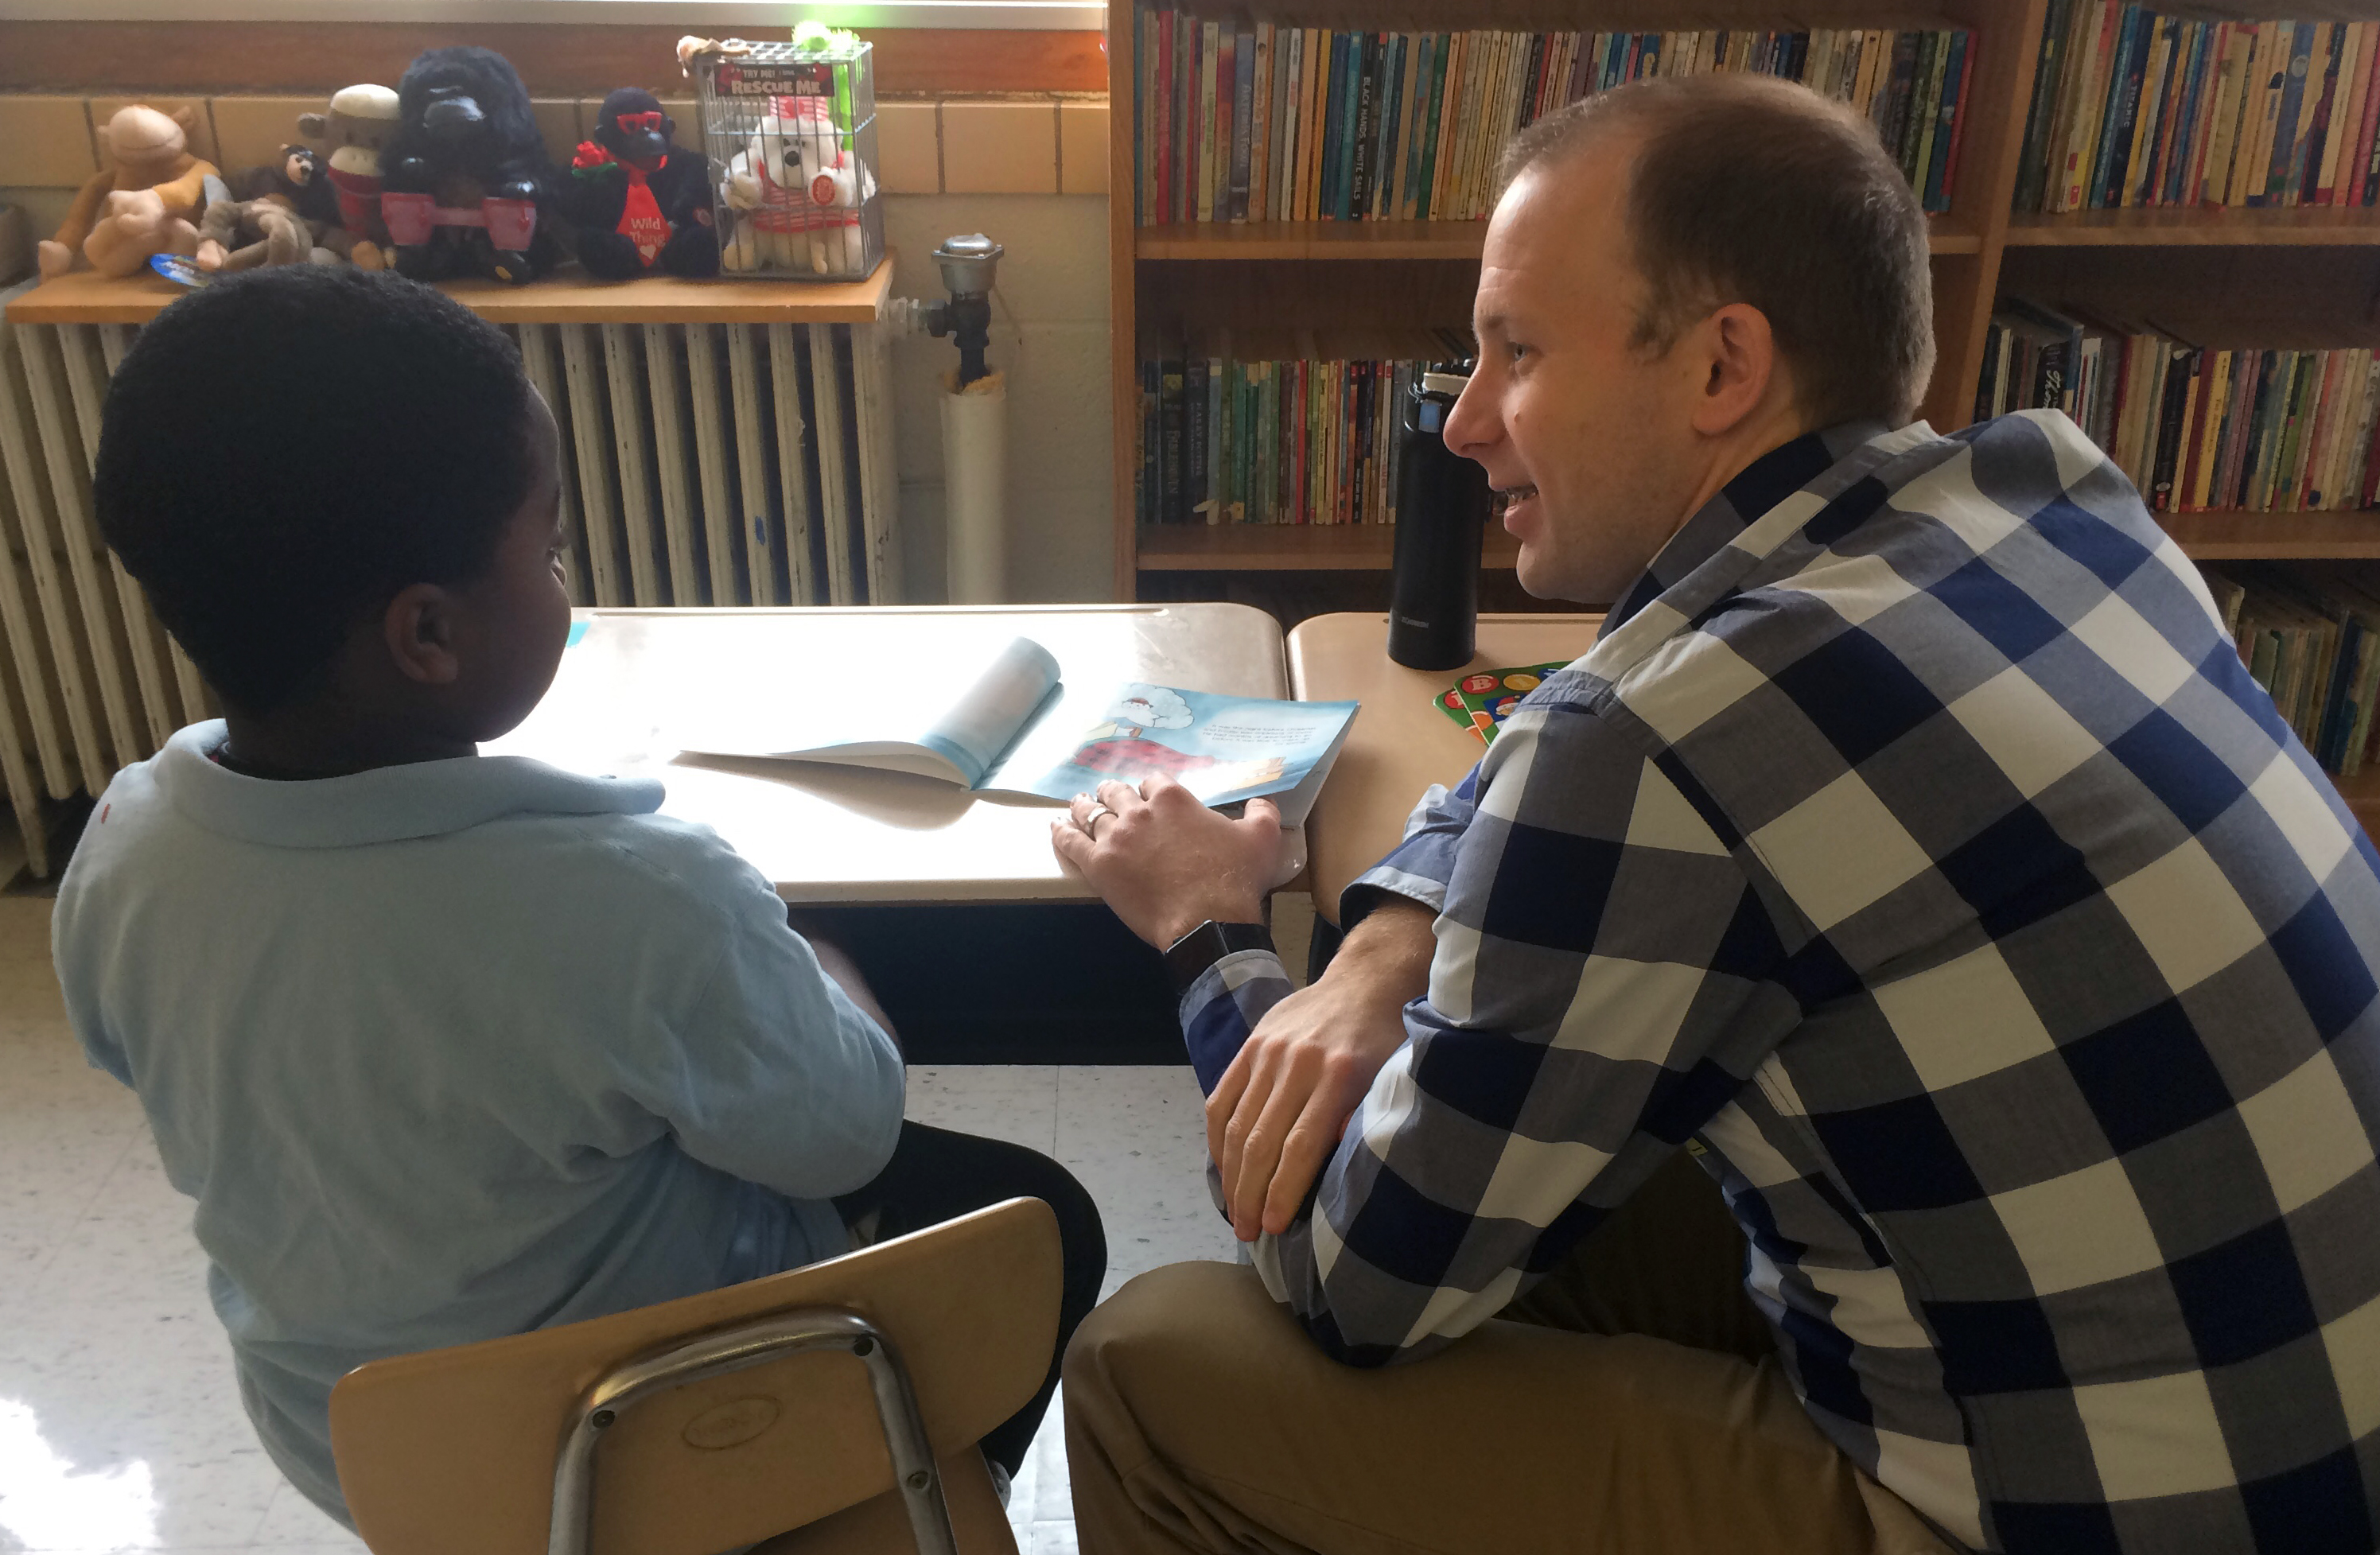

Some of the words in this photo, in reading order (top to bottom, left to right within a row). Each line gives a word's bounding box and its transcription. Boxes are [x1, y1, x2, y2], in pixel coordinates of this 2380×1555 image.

[744, 69, 758, 78] TRY
[731, 80, 794, 95] RESCUE
[797, 80, 821, 95] ME
[1362, 76, 1371, 106] BLACK
[2123, 85, 2137, 128] TITANIC
[1355, 144, 1365, 173] WHITE
[1353, 174, 1363, 200] SAILS
[631, 216, 660, 230] Wild
[1471, 678, 1491, 690] B
